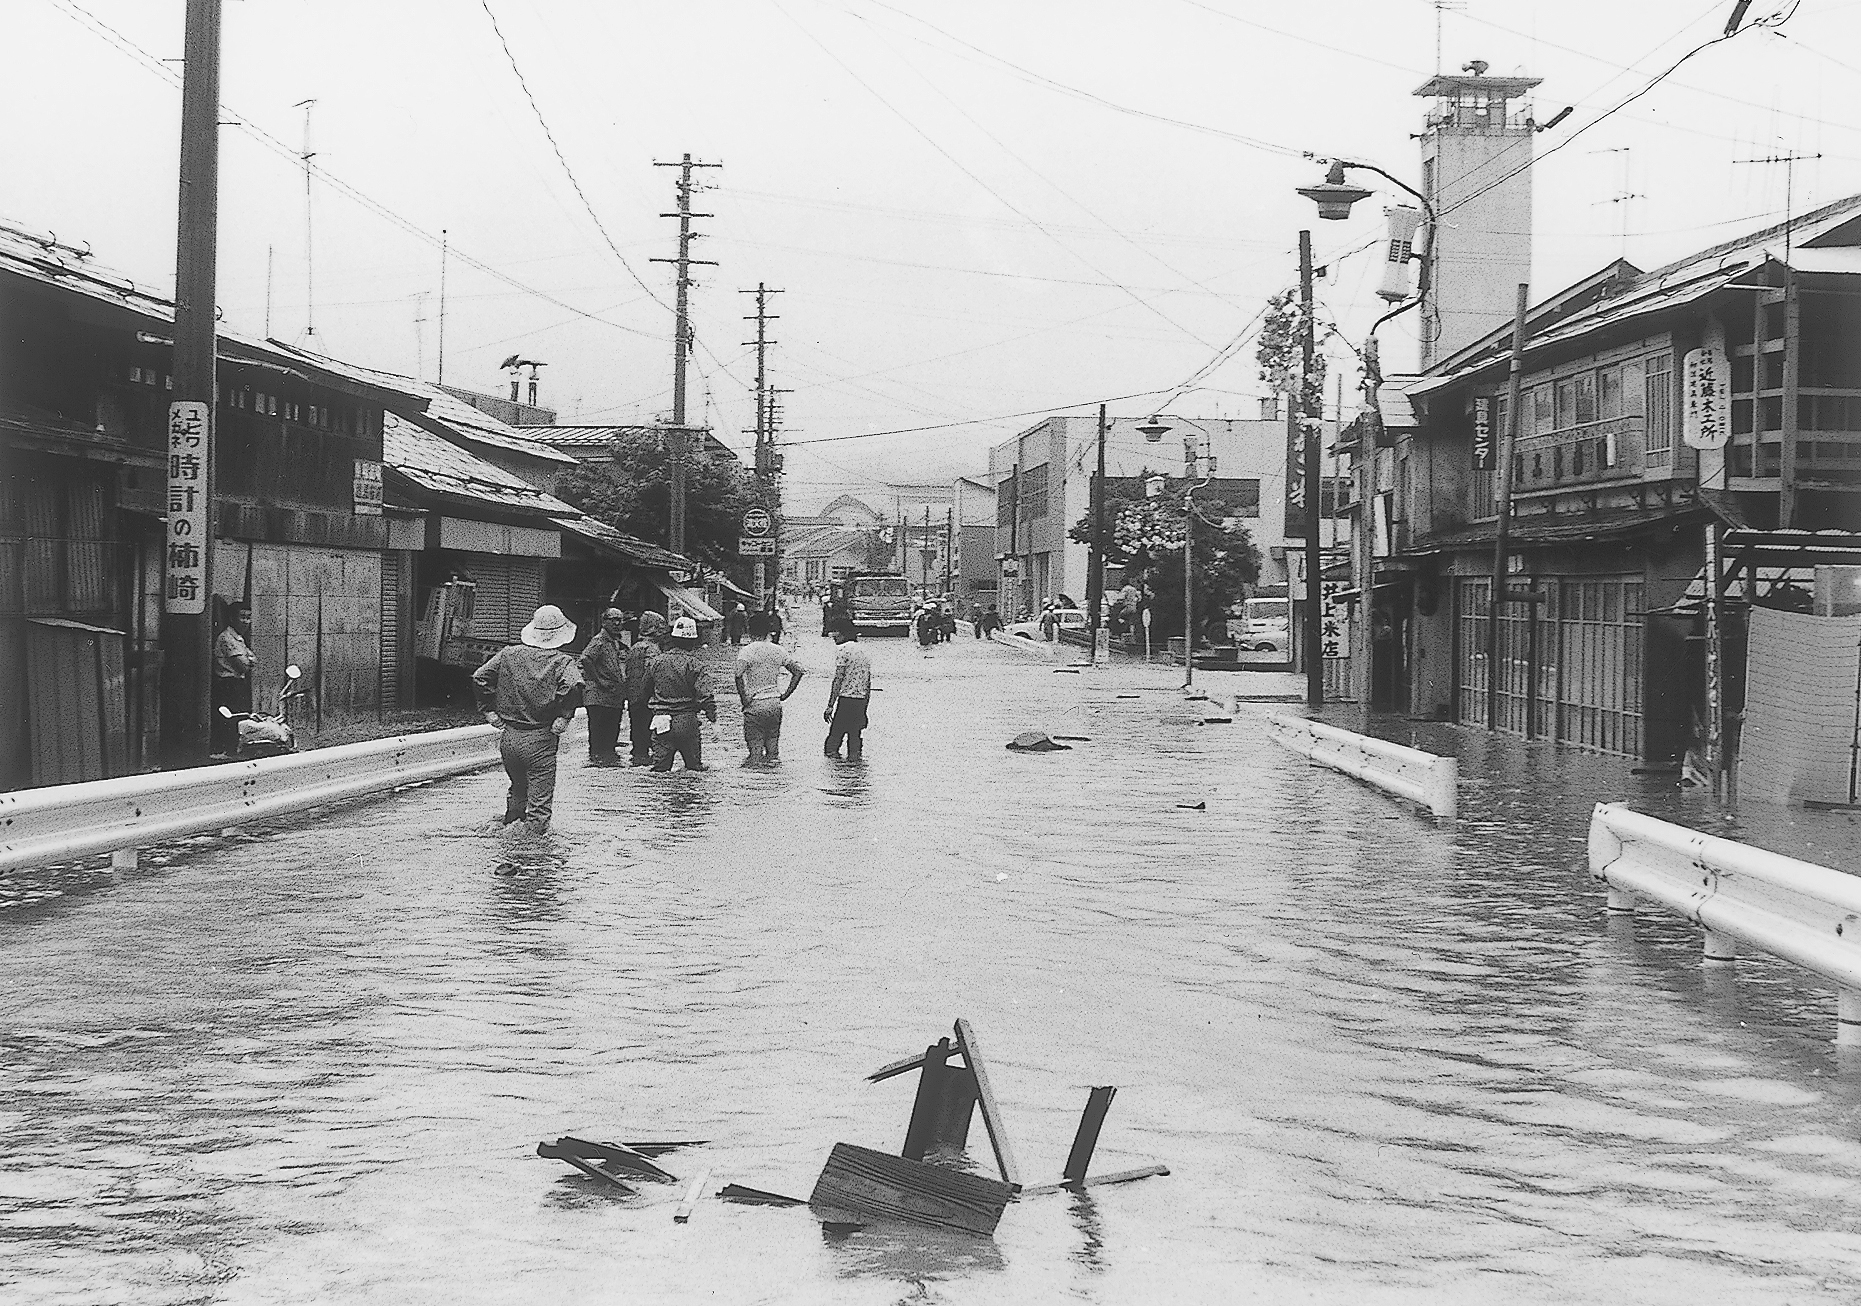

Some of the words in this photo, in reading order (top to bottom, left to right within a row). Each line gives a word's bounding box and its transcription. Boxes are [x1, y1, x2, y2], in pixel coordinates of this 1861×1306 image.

[1699, 367, 1717, 442] 近藤木工所
[168, 453, 200, 600] 時計の柿崎
[1321, 582, 1341, 658] 井上米店
